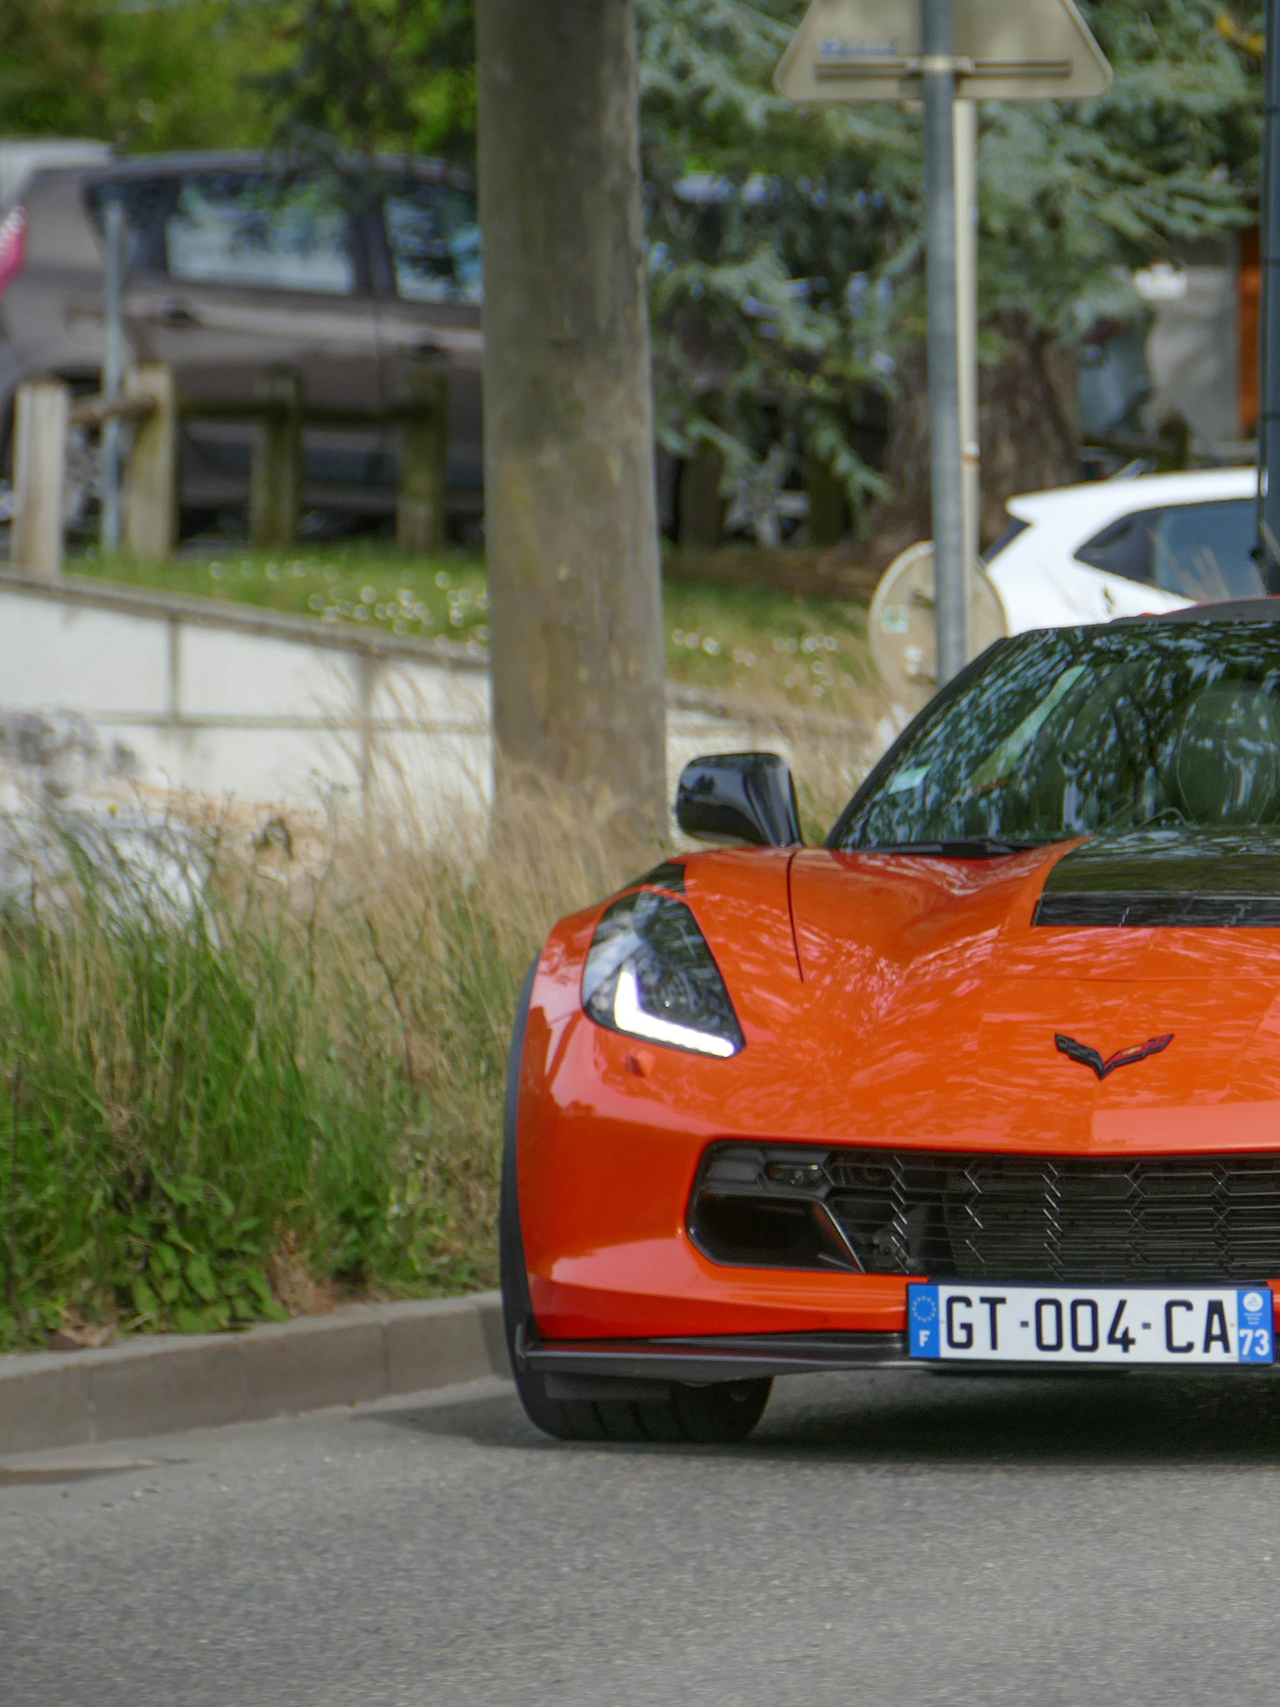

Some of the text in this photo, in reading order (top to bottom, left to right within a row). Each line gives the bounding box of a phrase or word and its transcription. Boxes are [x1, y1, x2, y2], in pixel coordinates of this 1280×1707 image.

[918, 1330, 931, 1347] F
[946, 1296, 1231, 1353] GT-004-CA
[1239, 1328, 1270, 1356] 73
